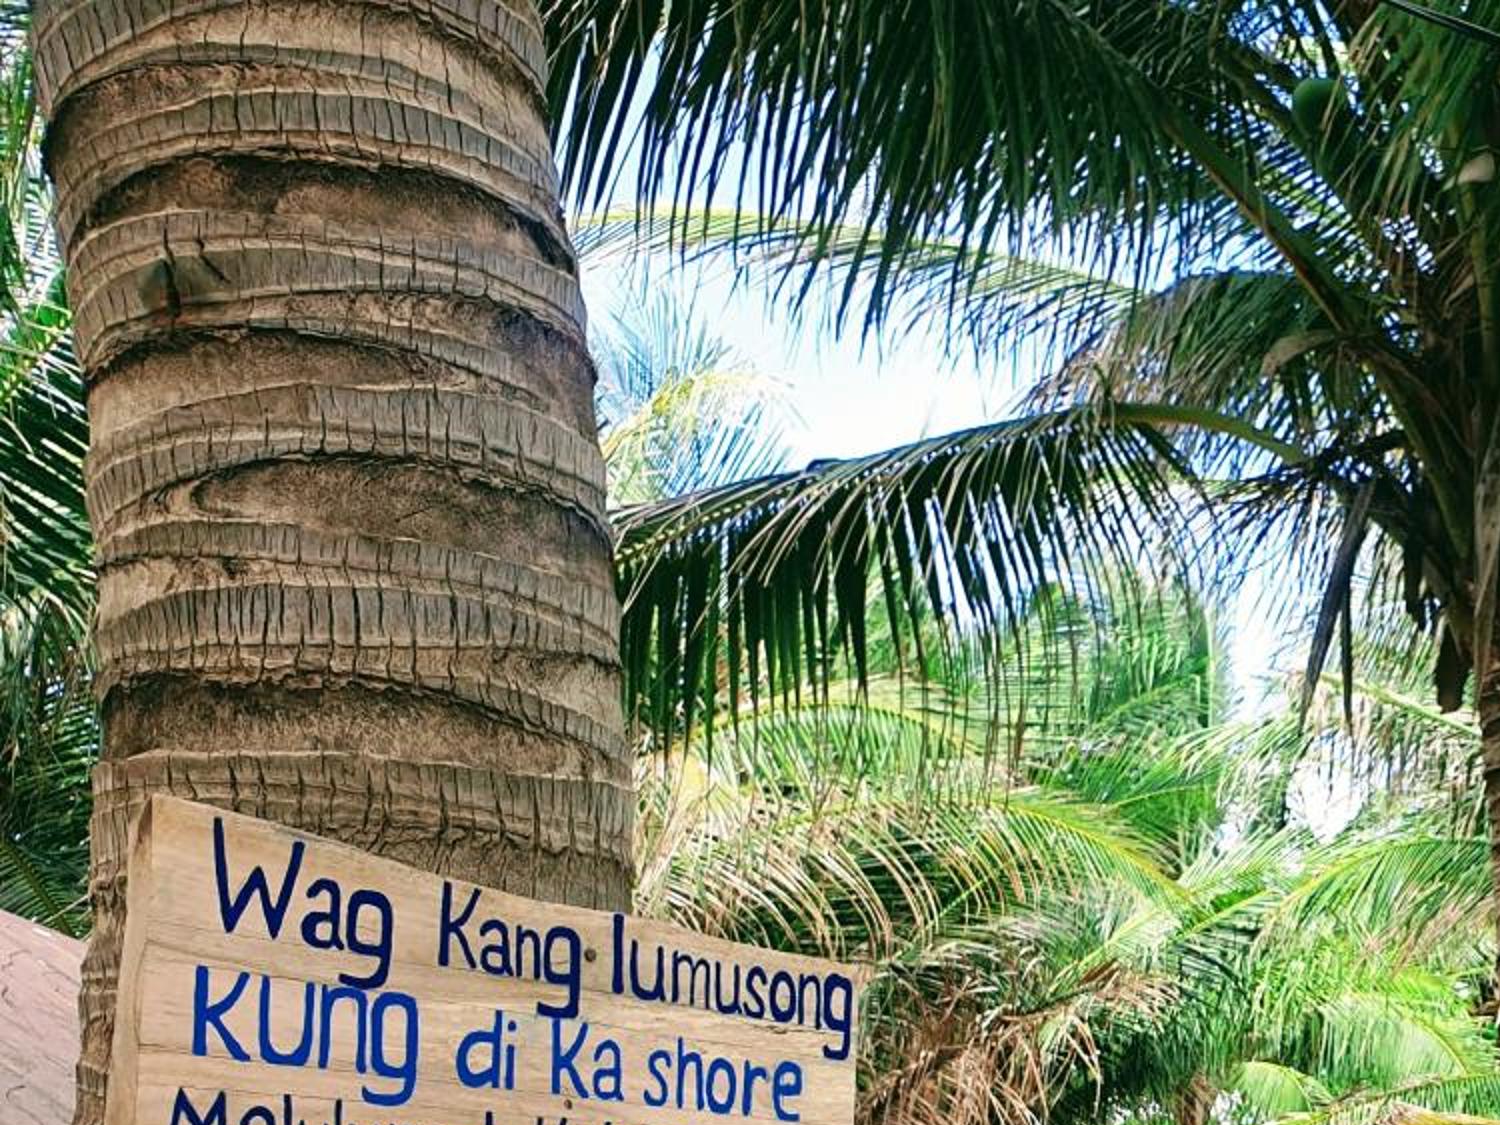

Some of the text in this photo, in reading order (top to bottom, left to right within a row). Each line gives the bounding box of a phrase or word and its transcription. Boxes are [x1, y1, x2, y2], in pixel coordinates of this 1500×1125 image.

[212, 816, 854, 1061] Wag Kang lumusong
[454, 1009, 517, 1091] di
[550, 1015, 624, 1102] Ka
[642, 1036, 803, 1122] shore
